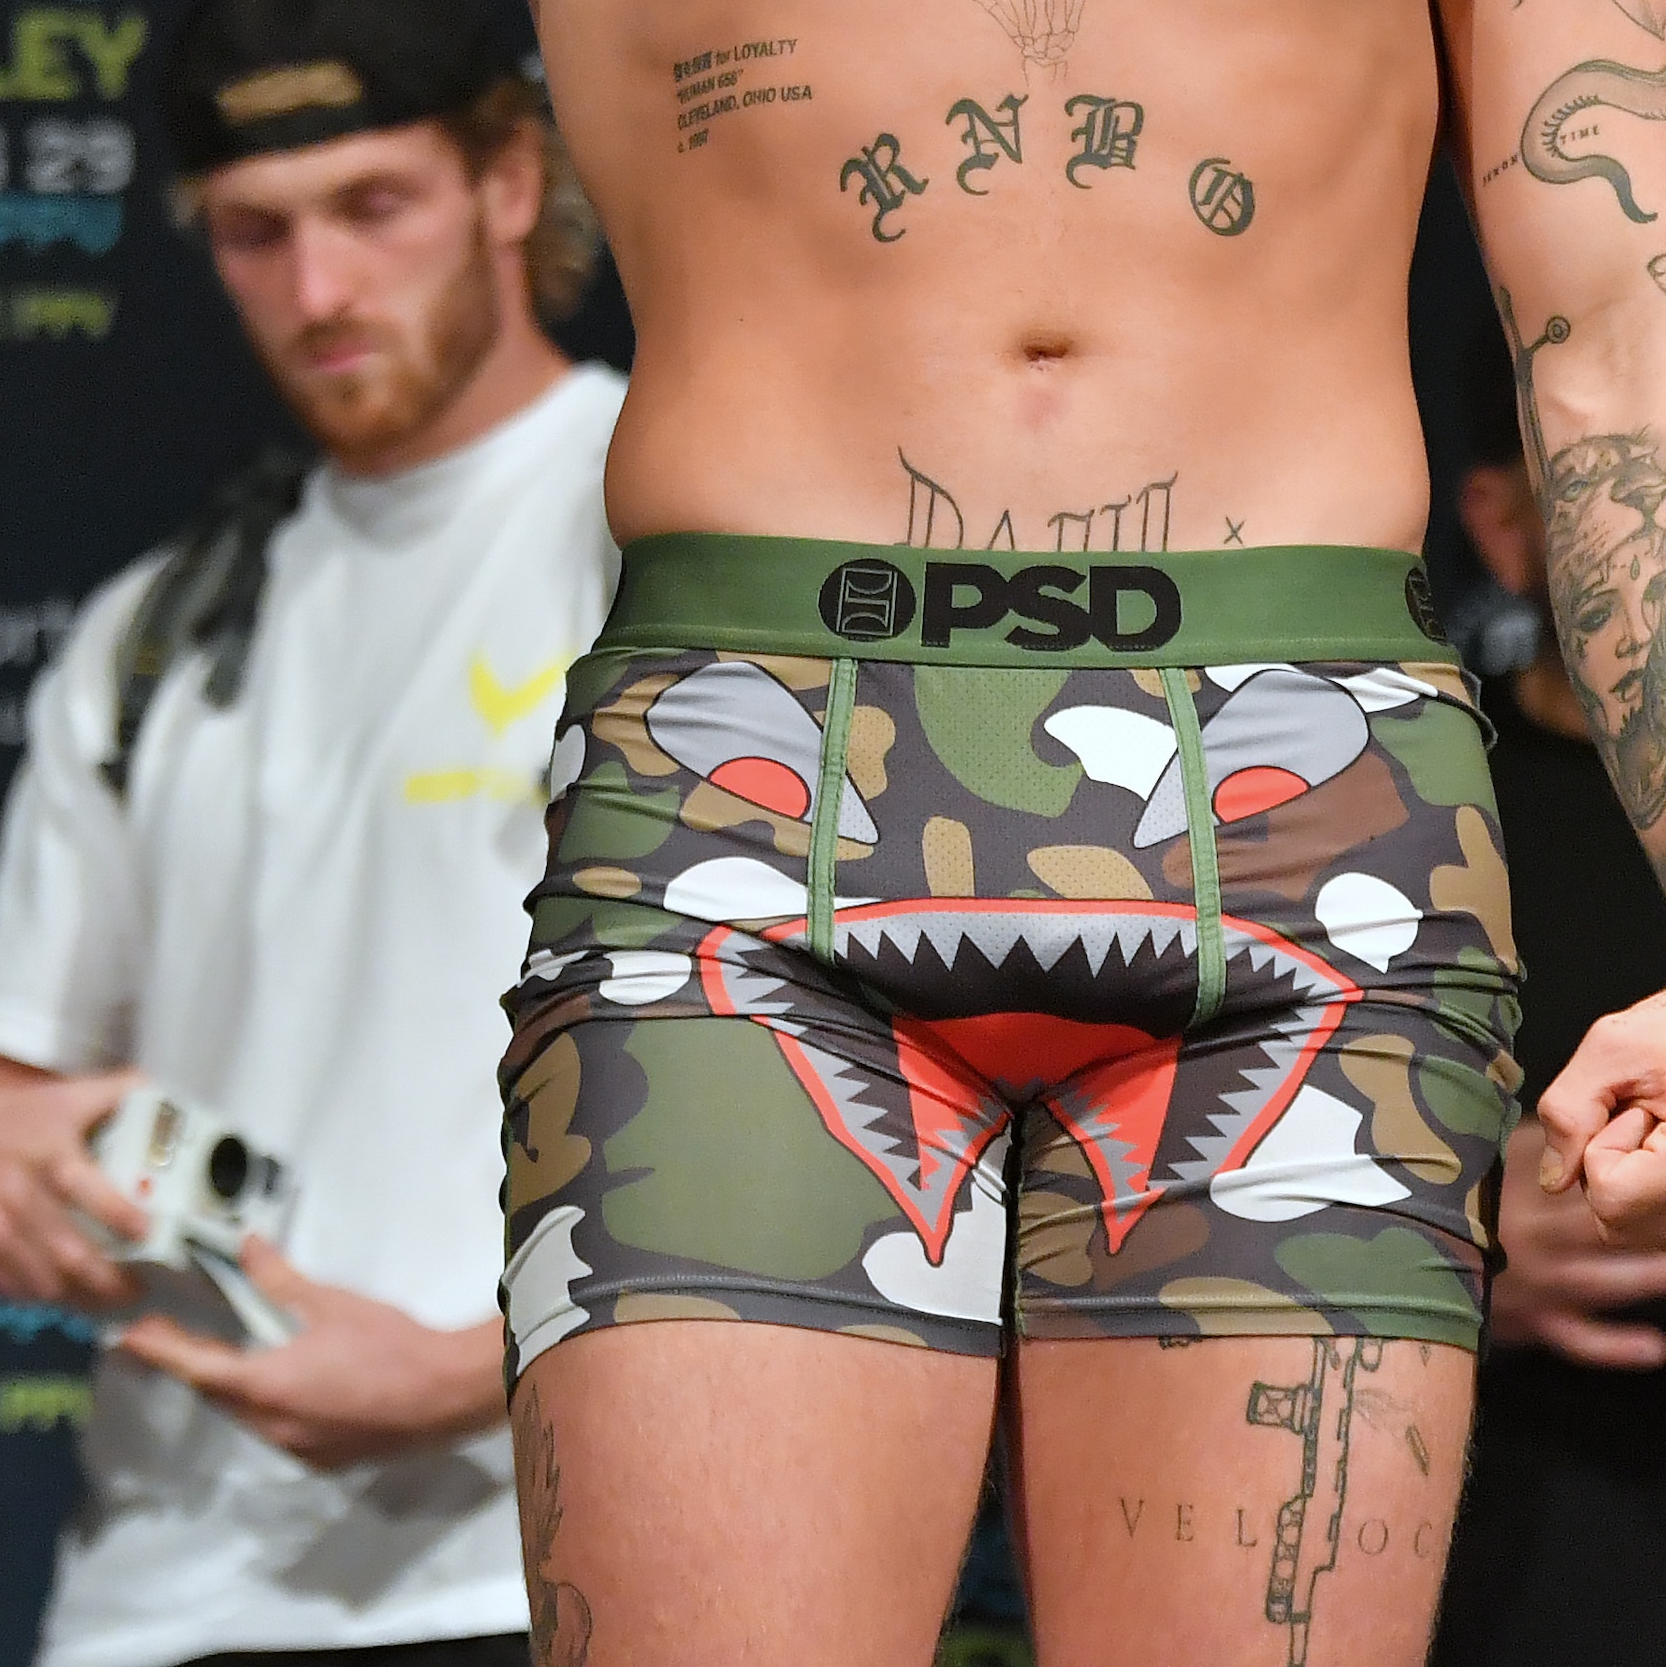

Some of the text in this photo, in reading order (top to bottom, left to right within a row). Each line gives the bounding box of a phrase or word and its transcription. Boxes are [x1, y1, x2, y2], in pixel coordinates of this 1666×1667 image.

[733, 38, 798, 63] LOYALTY
[742, 87, 777, 108] OHIO
[781, 84, 813, 103] USA
[24, 118, 135, 195] 29
[921, 562, 1181, 652] PSD
